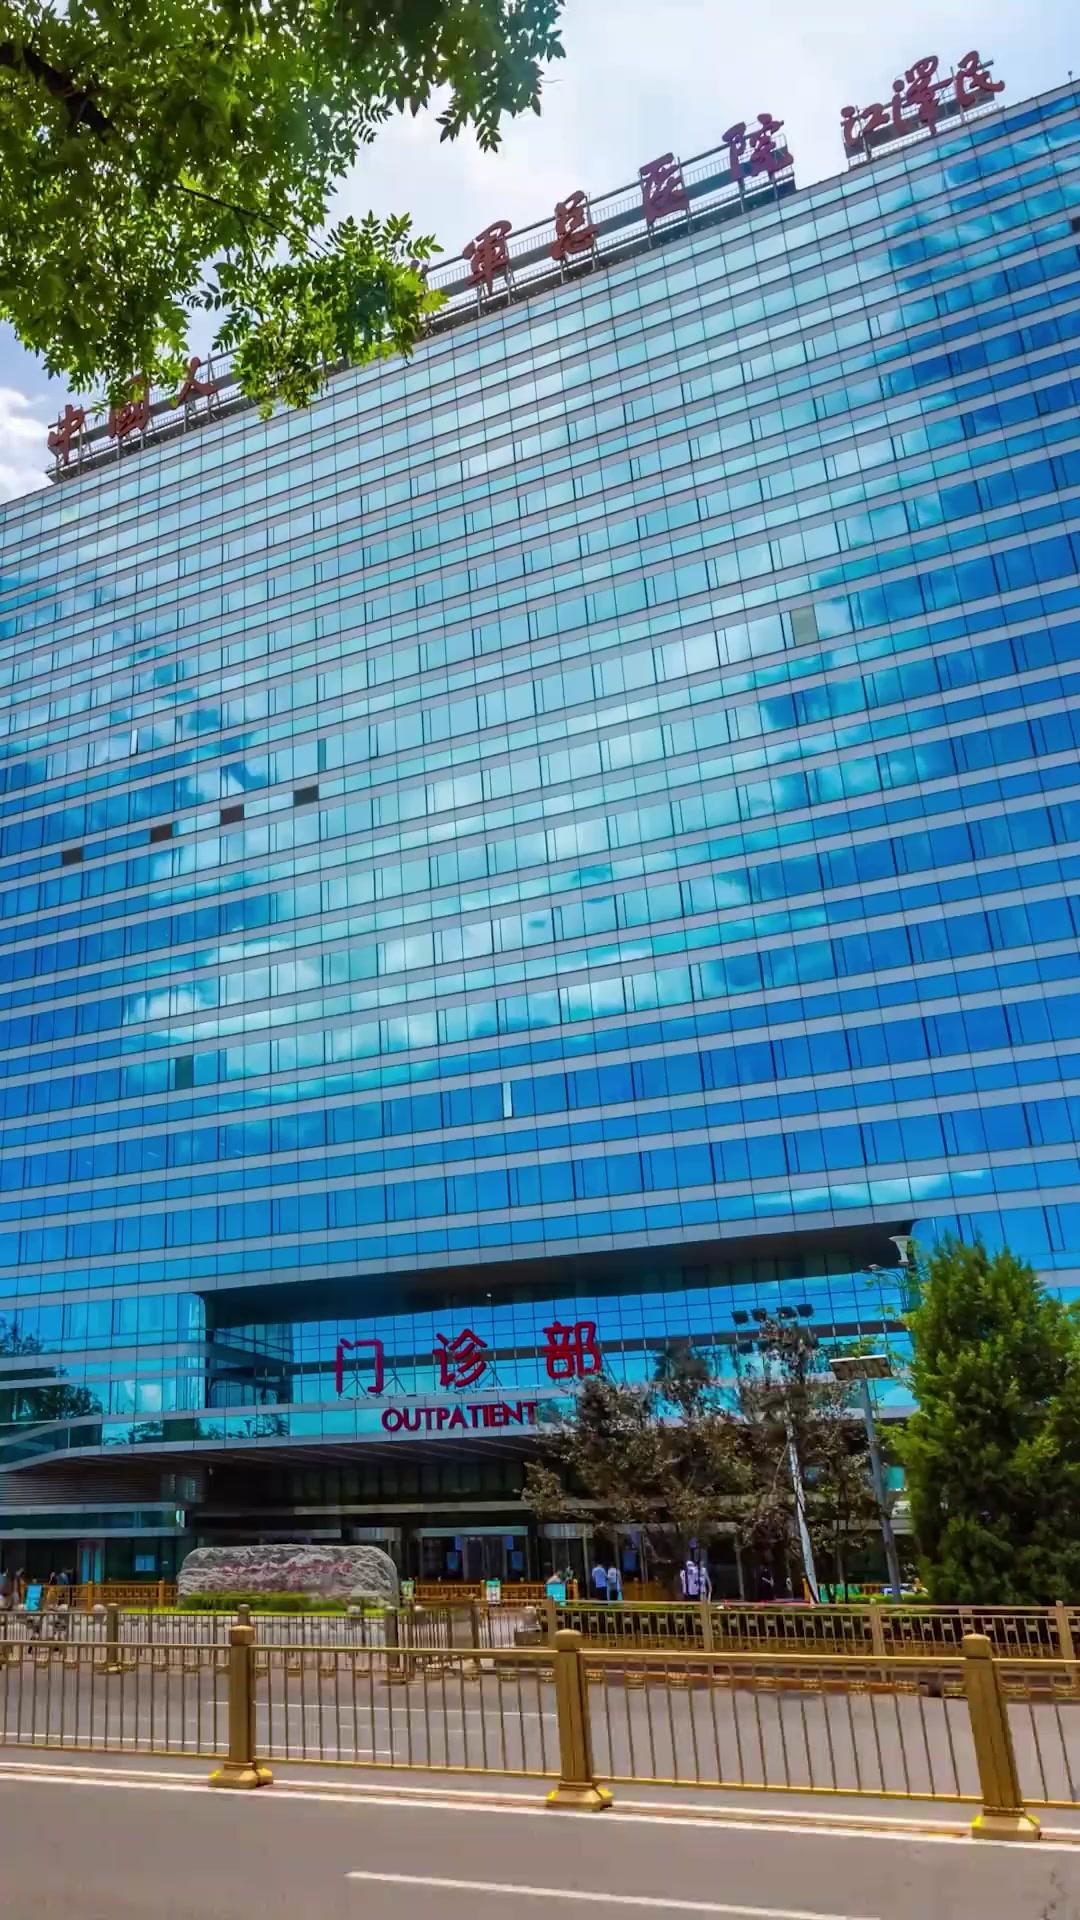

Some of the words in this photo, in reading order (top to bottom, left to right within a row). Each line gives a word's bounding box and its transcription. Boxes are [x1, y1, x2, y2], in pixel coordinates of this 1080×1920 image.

[336, 1321, 601, 1393] 门诊部
[381, 1401, 537, 1432] OUTPATIENT
